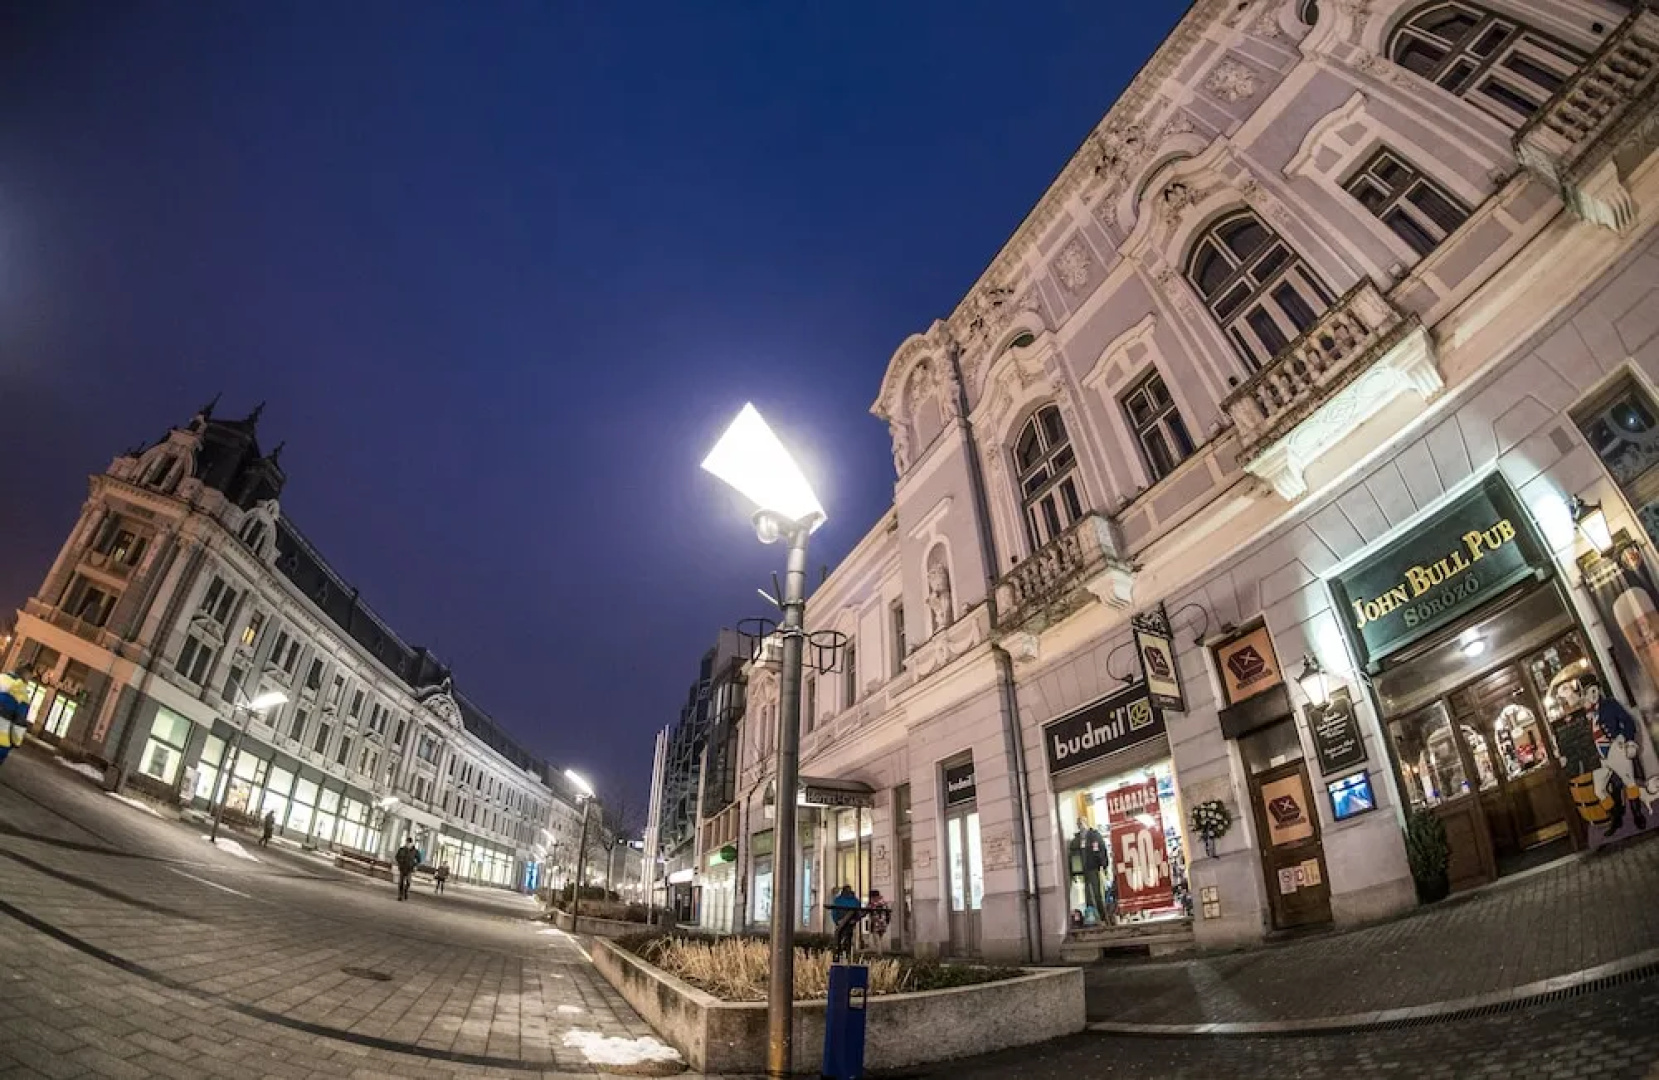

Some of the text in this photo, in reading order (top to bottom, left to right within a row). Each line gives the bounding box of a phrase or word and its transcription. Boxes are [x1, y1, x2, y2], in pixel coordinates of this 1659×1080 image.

[1351, 518, 1516, 629] JOHN BULL PUB
[1054, 707, 1125, 760] budmil
